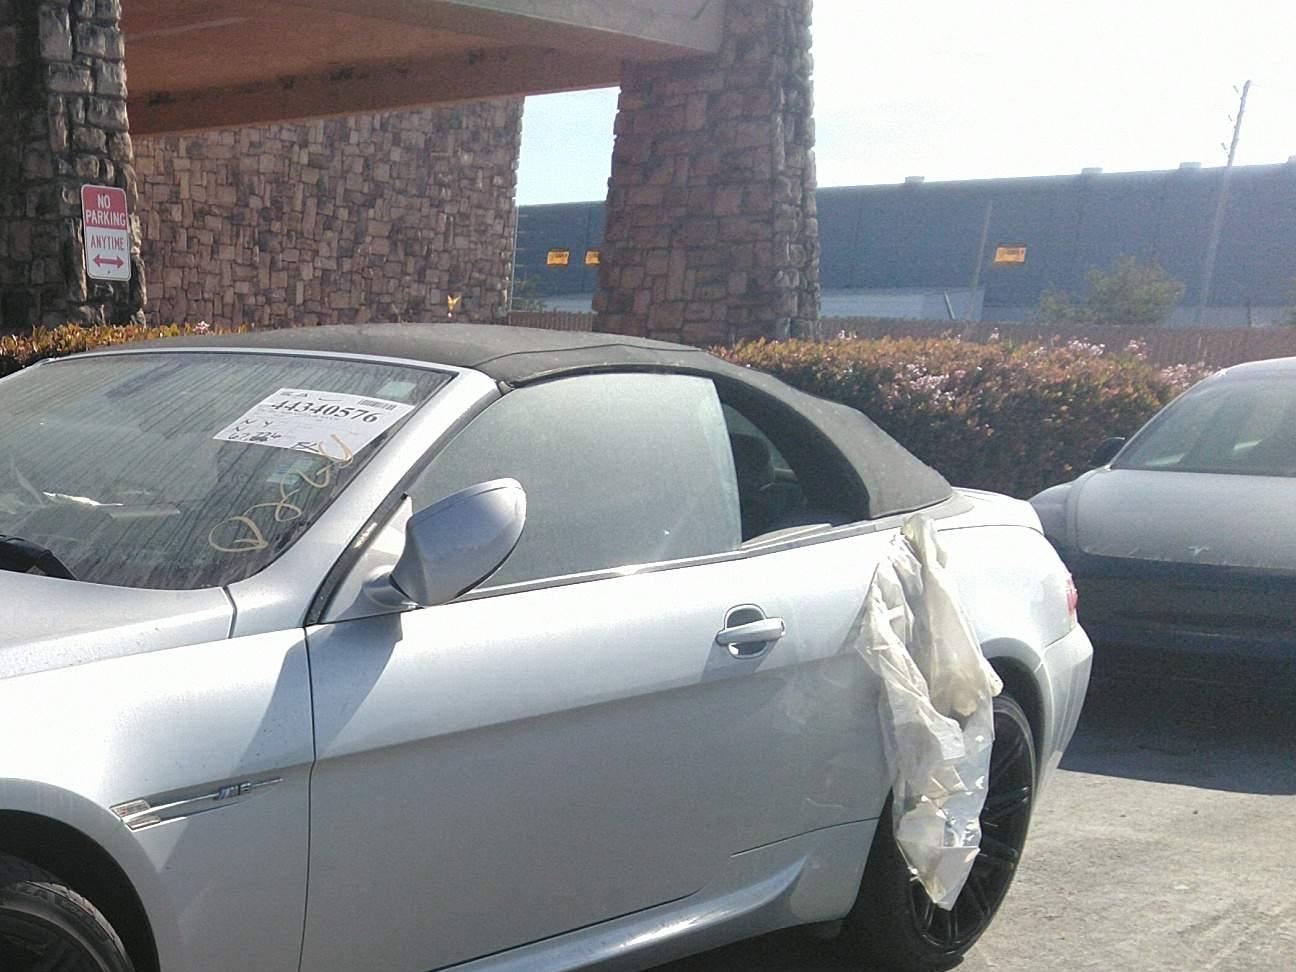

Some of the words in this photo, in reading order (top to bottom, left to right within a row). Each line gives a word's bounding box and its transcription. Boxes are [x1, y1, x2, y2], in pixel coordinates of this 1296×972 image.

[97, 194, 111, 209] NO
[85, 209, 126, 226] PARKING
[90, 235, 125, 251] ANYTIME
[271, 400, 381, 424] 44340576
